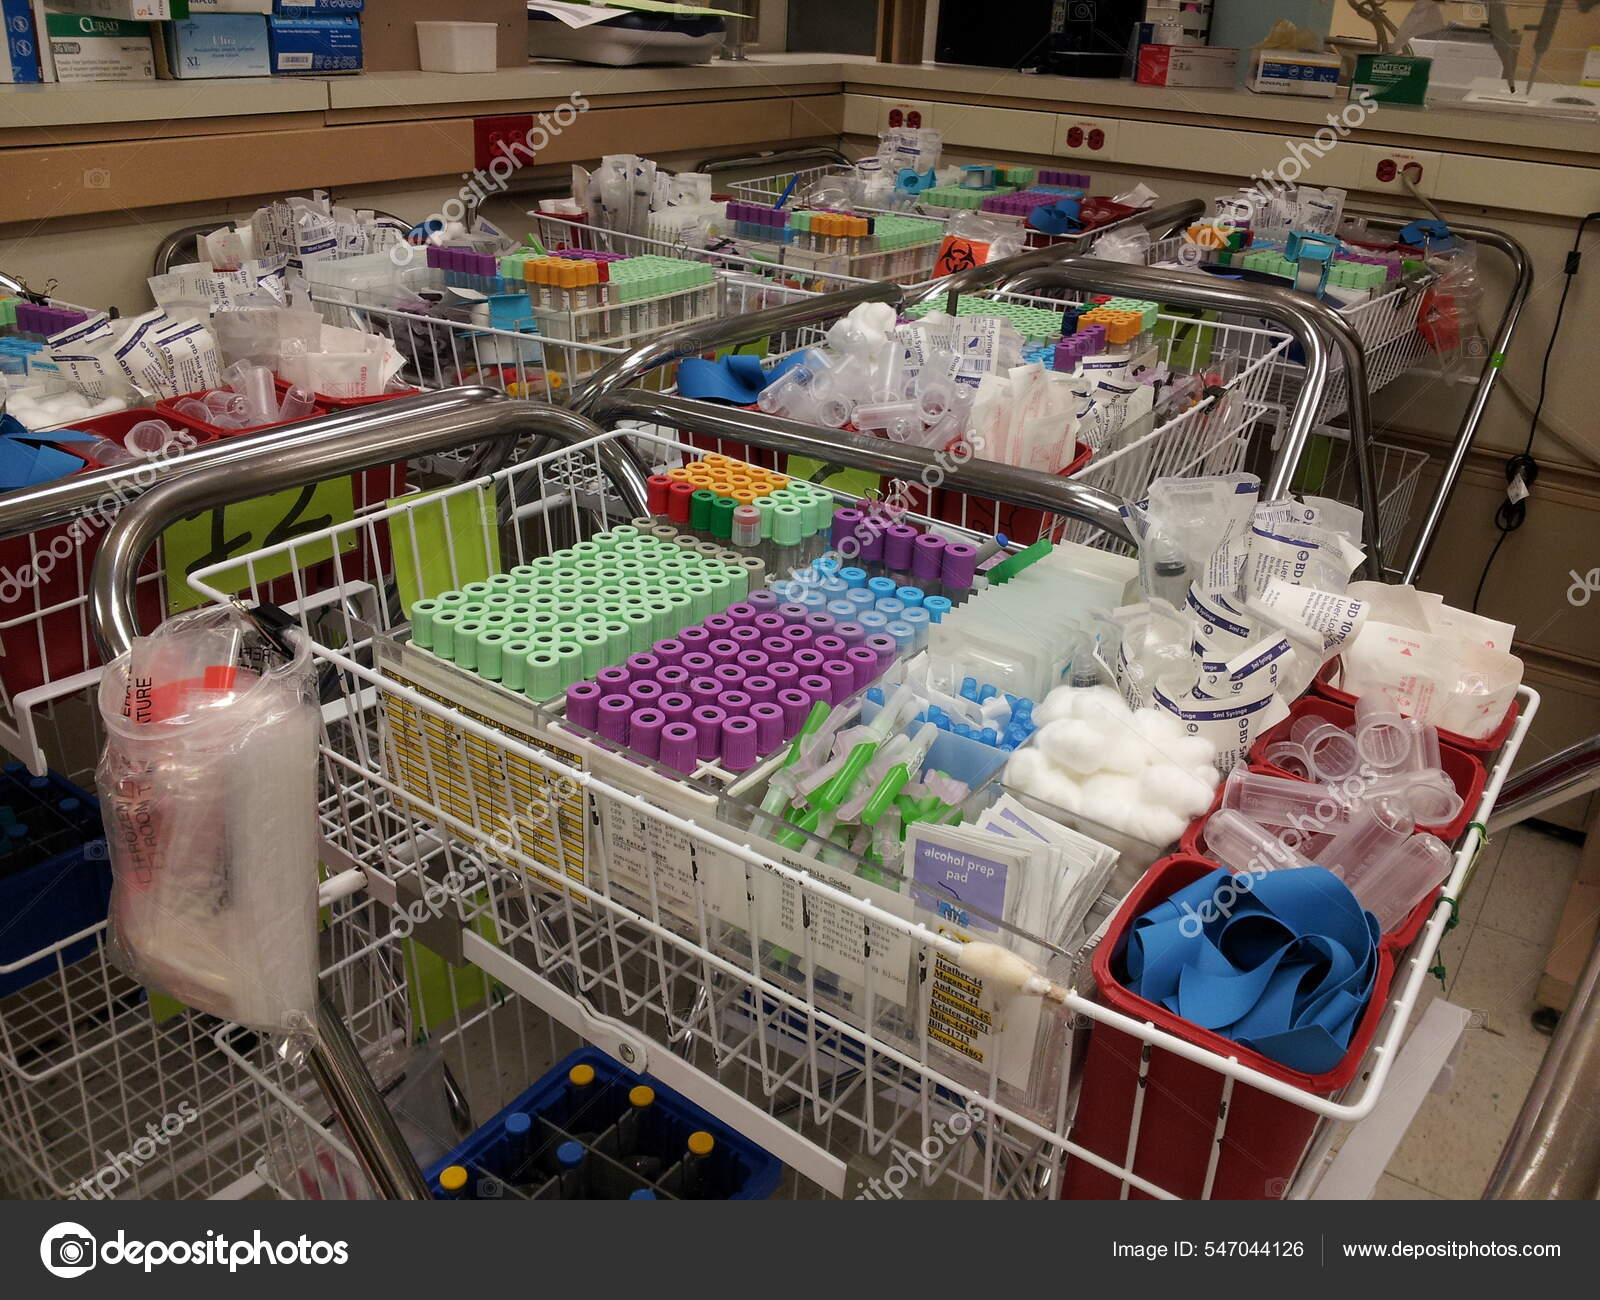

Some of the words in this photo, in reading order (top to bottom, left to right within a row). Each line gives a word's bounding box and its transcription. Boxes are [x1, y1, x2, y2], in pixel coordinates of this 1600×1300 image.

[1372, 63, 1411, 71] KIMTECH
[1294, 562, 1306, 578] BD
[1347, 602, 1361, 619] BD
[1226, 708, 1249, 719] Syringe
[1240, 728, 1248, 744] BD
[924, 847, 965, 867] alcohol
[967, 861, 994, 879] prep
[946, 870, 968, 884] pad
